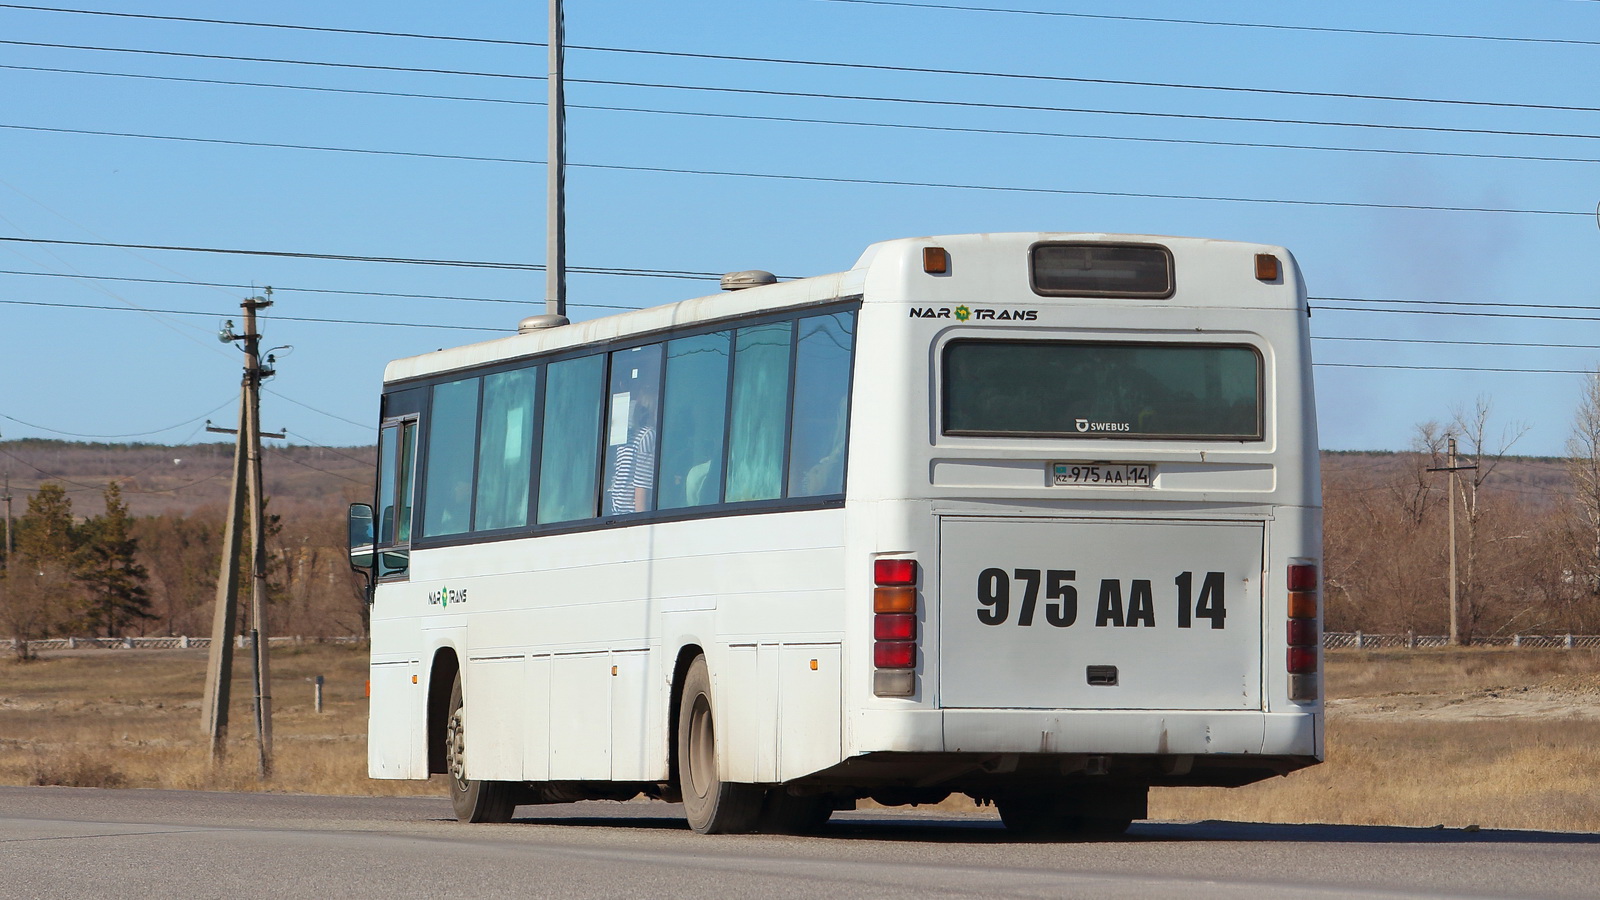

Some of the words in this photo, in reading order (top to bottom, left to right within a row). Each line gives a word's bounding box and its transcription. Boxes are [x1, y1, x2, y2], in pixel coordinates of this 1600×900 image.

[909, 307, 951, 318] NAR
[974, 309, 1038, 321] TRANS
[1090, 422, 1130, 431] SWEBUS
[1071, 467, 1100, 482] 975
[1104, 470, 1123, 483] AA
[1129, 468, 1147, 483] 14
[428, 591, 441, 605] NAR
[449, 589, 467, 603] TRANS
[977, 568, 1078, 628] 975
[1095, 579, 1156, 627] AA
[1175, 571, 1227, 629] 14
